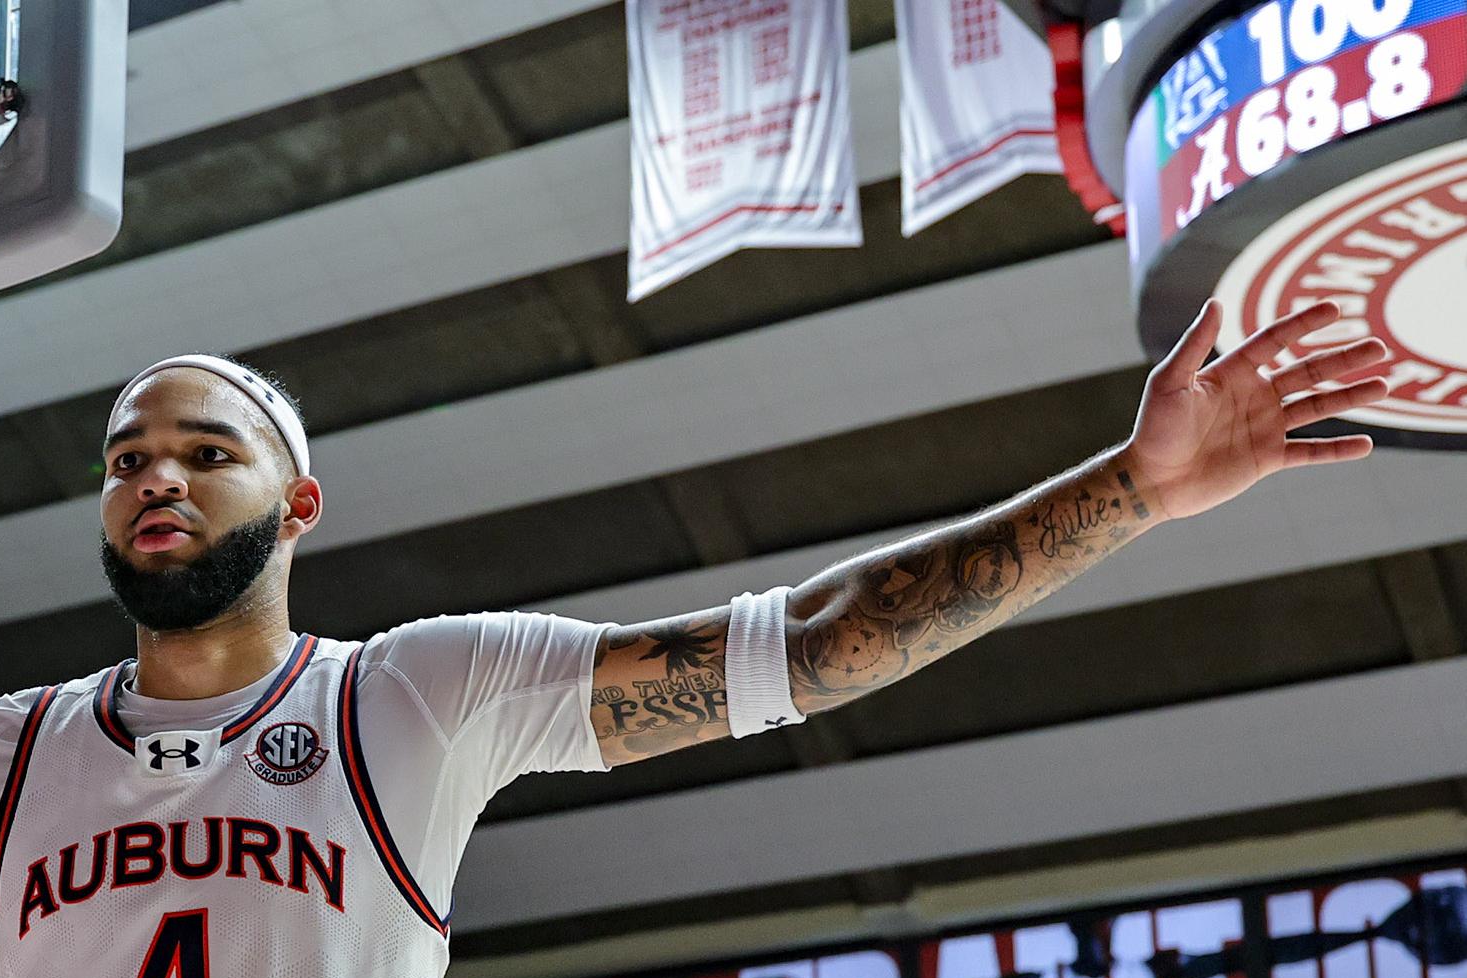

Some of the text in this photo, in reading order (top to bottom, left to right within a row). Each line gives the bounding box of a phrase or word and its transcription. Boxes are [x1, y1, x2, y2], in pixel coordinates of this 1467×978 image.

[1236, 32, 1432, 178] 68.8
[632, 671, 720, 698] TIMES
[264, 725, 313, 767] SEC
[254, 761, 317, 783] GRADUATE
[18, 816, 346, 940] AUBURN
